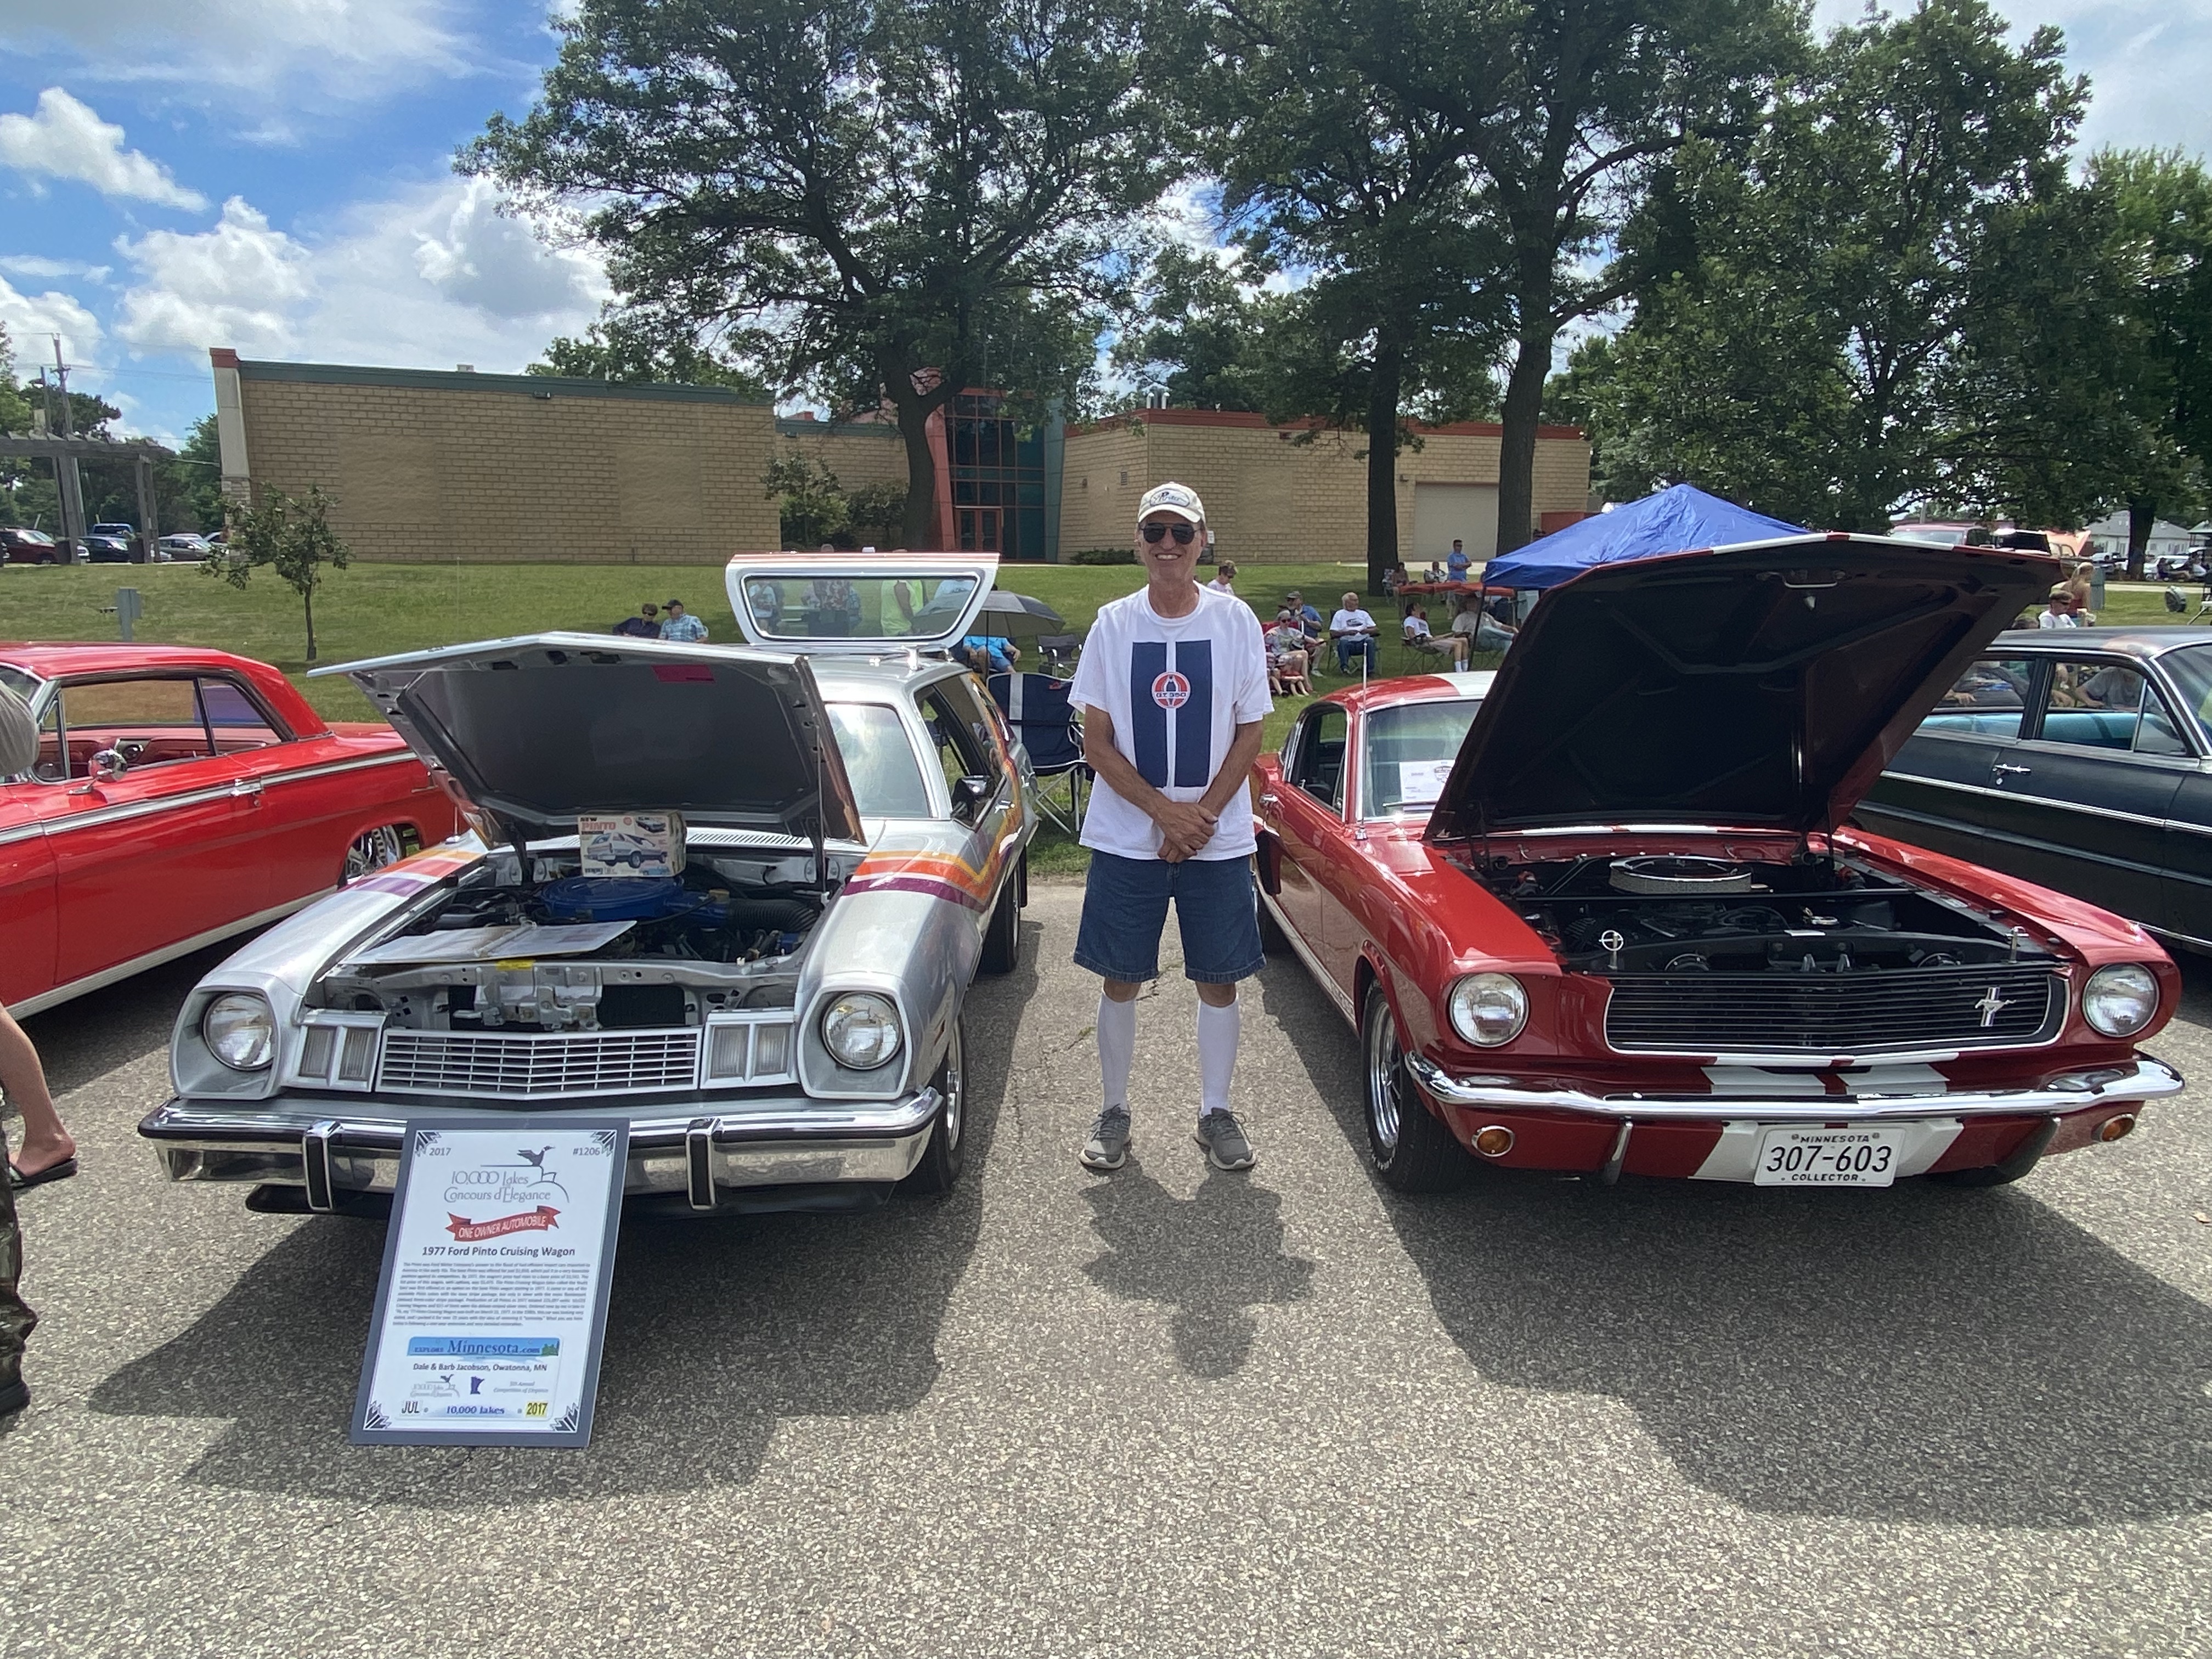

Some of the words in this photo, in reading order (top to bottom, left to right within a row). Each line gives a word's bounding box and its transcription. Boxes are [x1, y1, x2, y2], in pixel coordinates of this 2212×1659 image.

[582, 822, 616, 830] PINTO
[1800, 1135, 1870, 1143] MINNESOTA
[429, 1148, 451, 1156] 2017
[1766, 1145, 1892, 1173] 307-603
[452, 1170, 500, 1186] 10,000
[1791, 1173, 1859, 1182] COLLECTOR
[443, 1186, 492, 1203] Concours
[458, 1227, 473, 1238] ONE
[474, 1222, 500, 1238] OWNER
[501, 1215, 548, 1232] AUTOMOBILE
[422, 1246, 445, 1256] 1977
[448, 1246, 470, 1256] Ford
[471, 1246, 497, 1256] Pinto
[499, 1246, 539, 1257] Cruising
[541, 1246, 575, 1258] Wagon
[456, 1363, 491, 1372] Jacobson,
[493, 1364, 532, 1372] Owatonna,
[401, 1401, 420, 1413] JUL
[446, 1406, 477, 1415] 10,000
[526, 1402, 548, 1416] 2017
